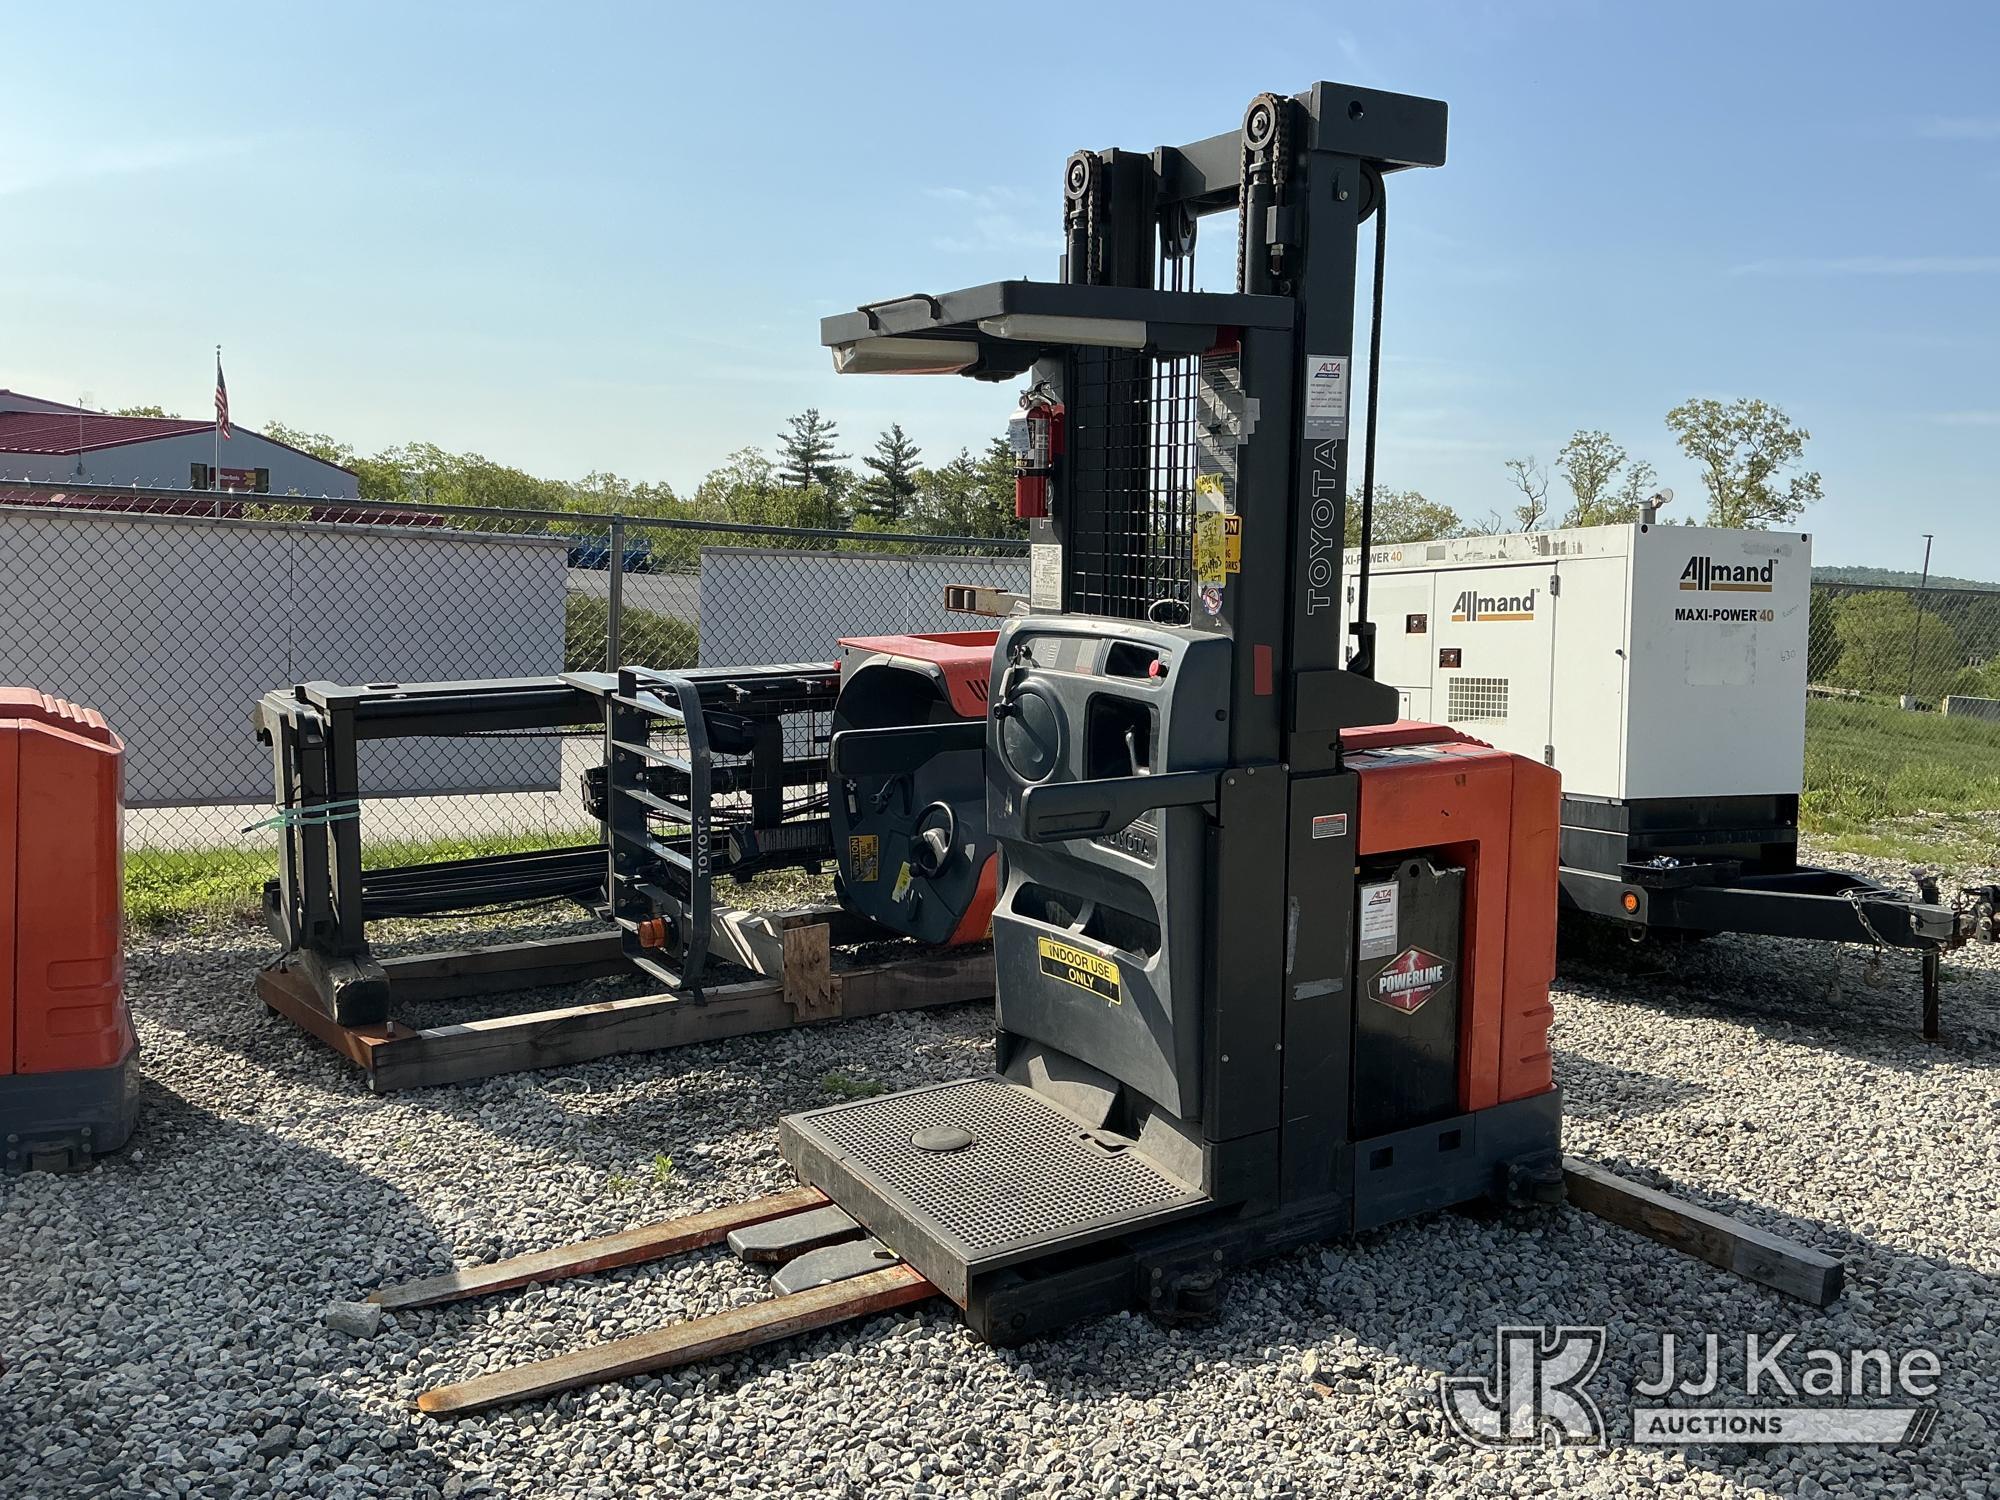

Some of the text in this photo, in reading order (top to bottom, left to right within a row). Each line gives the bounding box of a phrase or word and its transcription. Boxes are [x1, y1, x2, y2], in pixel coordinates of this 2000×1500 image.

[1319, 362, 1341, 372] ALTA
[1307, 438, 1337, 615] TOYOTA
[1391, 551, 1403, 562] 40
[1680, 556, 1774, 591] Allmand
[1451, 589, 1535, 622] Allmand
[1675, 608, 1774, 622] MAXI-POWER 40
[1372, 889, 1392, 900] ALTA
[1049, 944, 1110, 978] INDOOR USE
[1068, 968, 1095, 988] ONLY
[1378, 965, 1443, 994] POWERLINE
